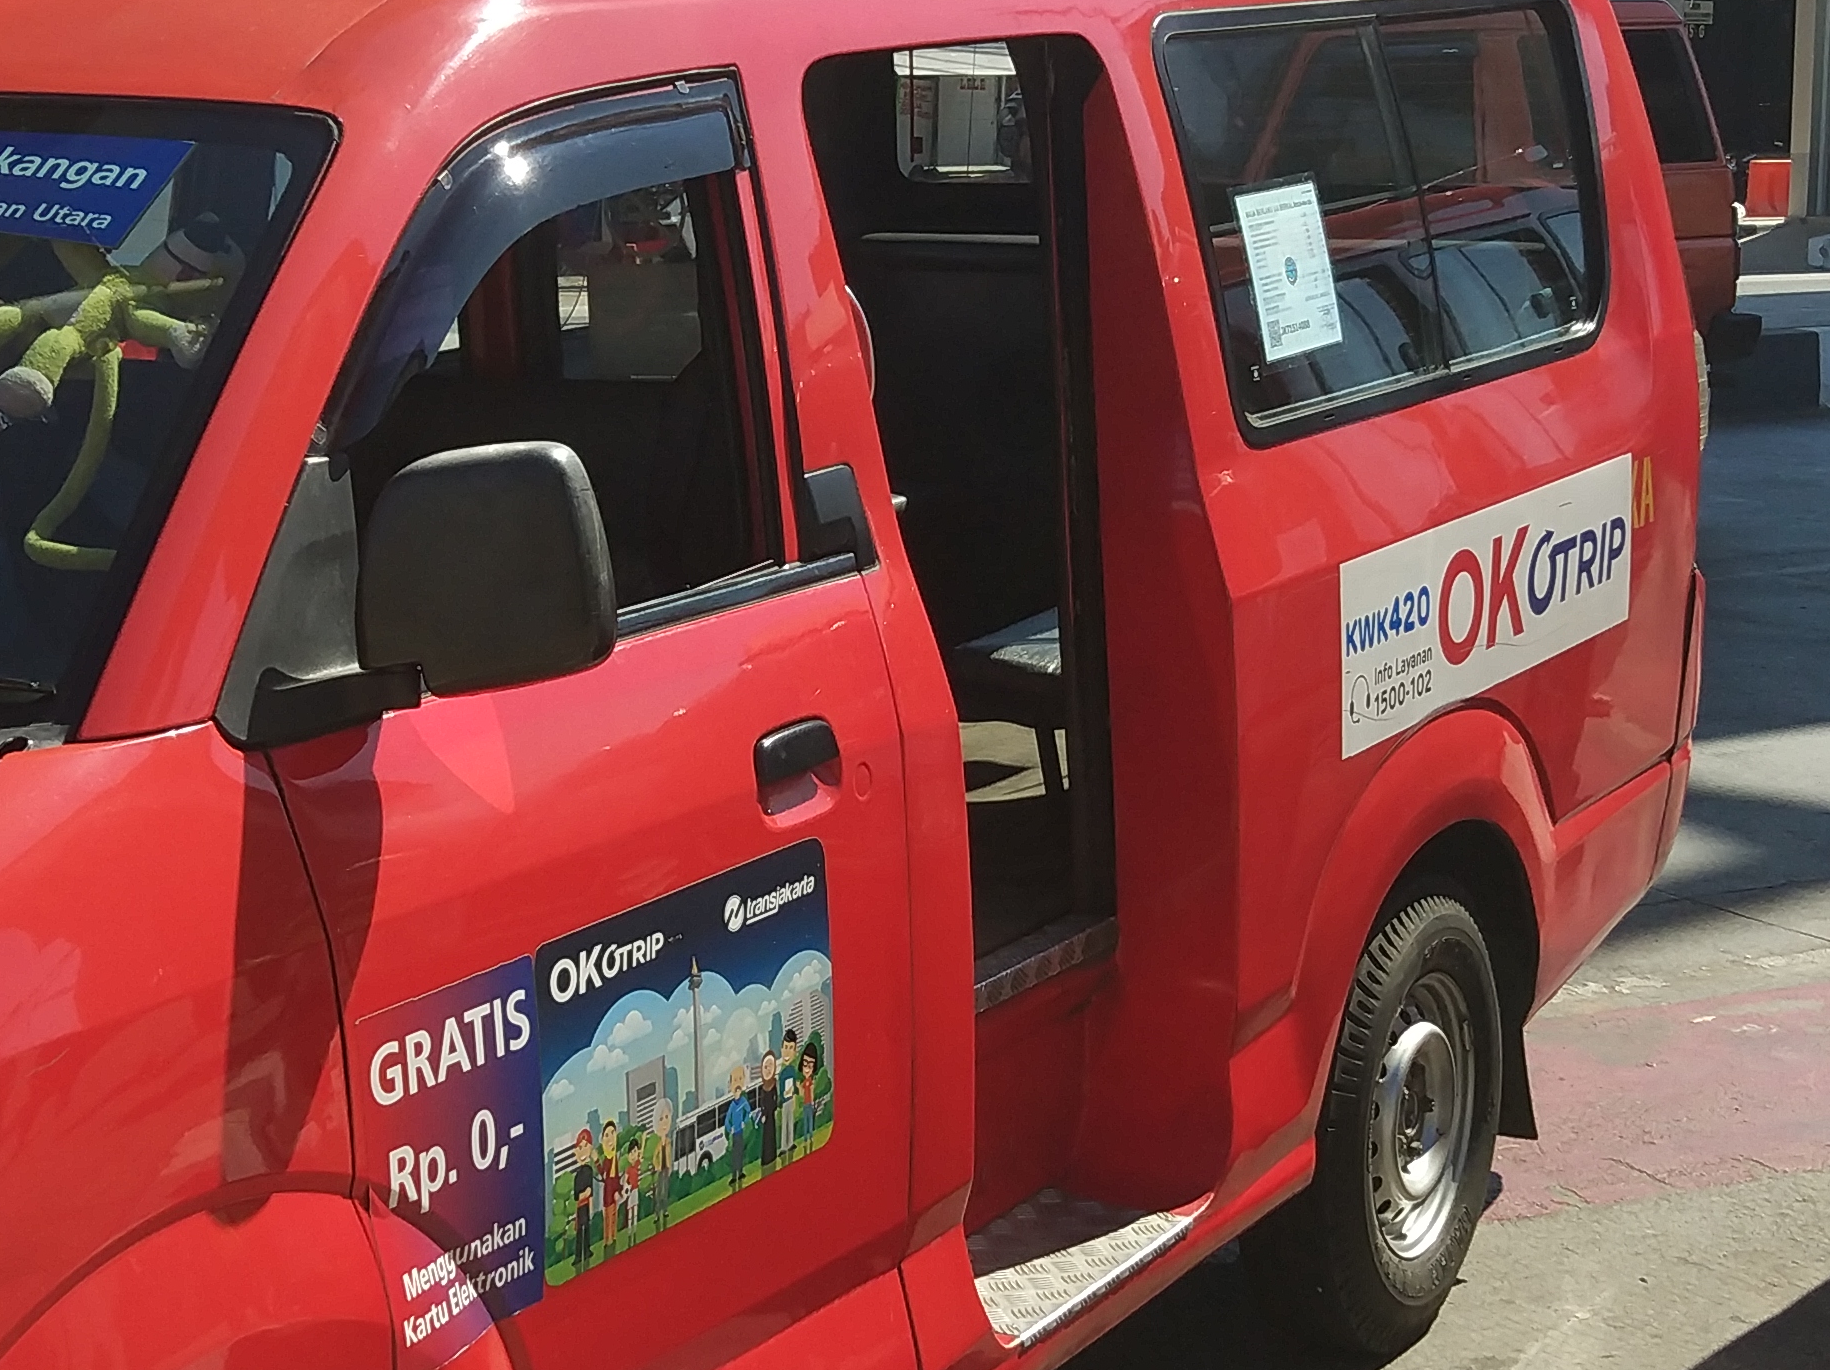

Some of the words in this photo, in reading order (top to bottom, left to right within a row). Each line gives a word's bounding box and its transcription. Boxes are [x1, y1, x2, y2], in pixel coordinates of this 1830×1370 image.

[33, 202, 112, 229] Utara
[1345, 585, 1431, 657] KWK420
[1375, 662, 1393, 685] Info
[1396, 647, 1432, 676] Layanan
[747, 874, 816, 921] transjakarta
[370, 988, 531, 1107] GRATIS
[388, 1143, 459, 1214] Rp.
[402, 1216, 527, 1302] Menggunakan
[403, 1304, 450, 1347] Kartu
[450, 1246, 535, 1316] Elektronik
